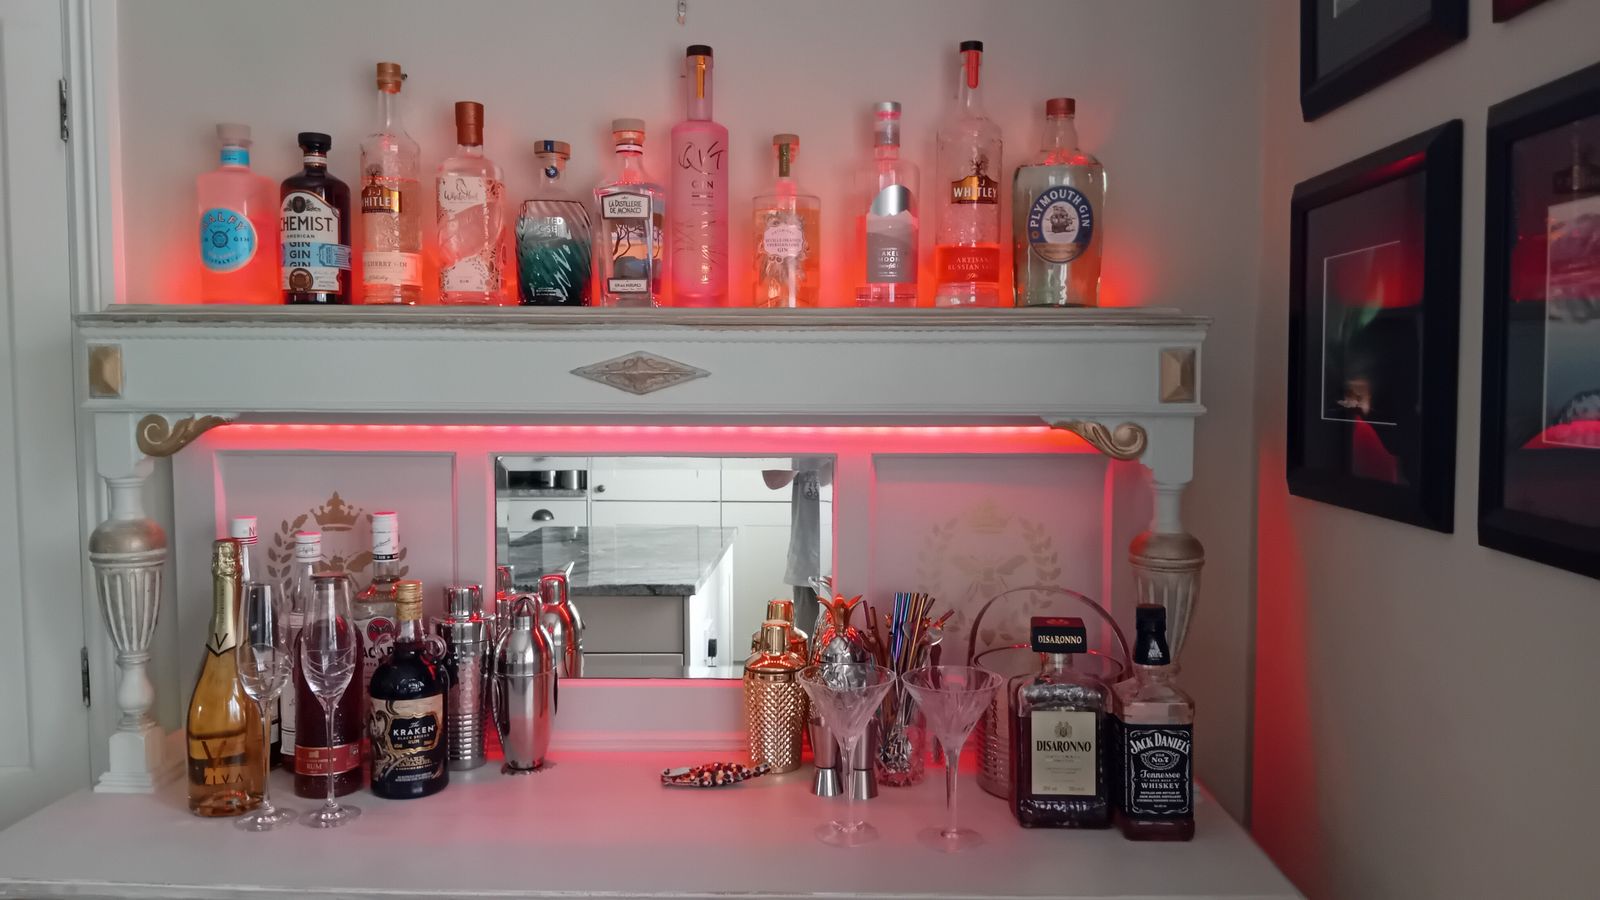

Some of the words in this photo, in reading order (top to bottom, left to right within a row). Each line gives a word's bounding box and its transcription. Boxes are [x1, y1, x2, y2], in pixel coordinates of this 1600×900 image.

[953, 187, 996, 197] WHTLEY
[363, 196, 397, 207] HITLE
[1030, 189, 1082, 228] PLYMOUTH
[1079, 204, 1090, 227] GIN
[290, 250, 310, 259] GIN
[1038, 635, 1083, 645] DISARONNO
[393, 725, 434, 736] KRAKEN
[1036, 740, 1092, 753] DISARONNO
[1130, 737, 1154, 754] JACK
[1154, 732, 1190, 755] DANIEL'S
[1140, 769, 1180, 778] Tennessee
